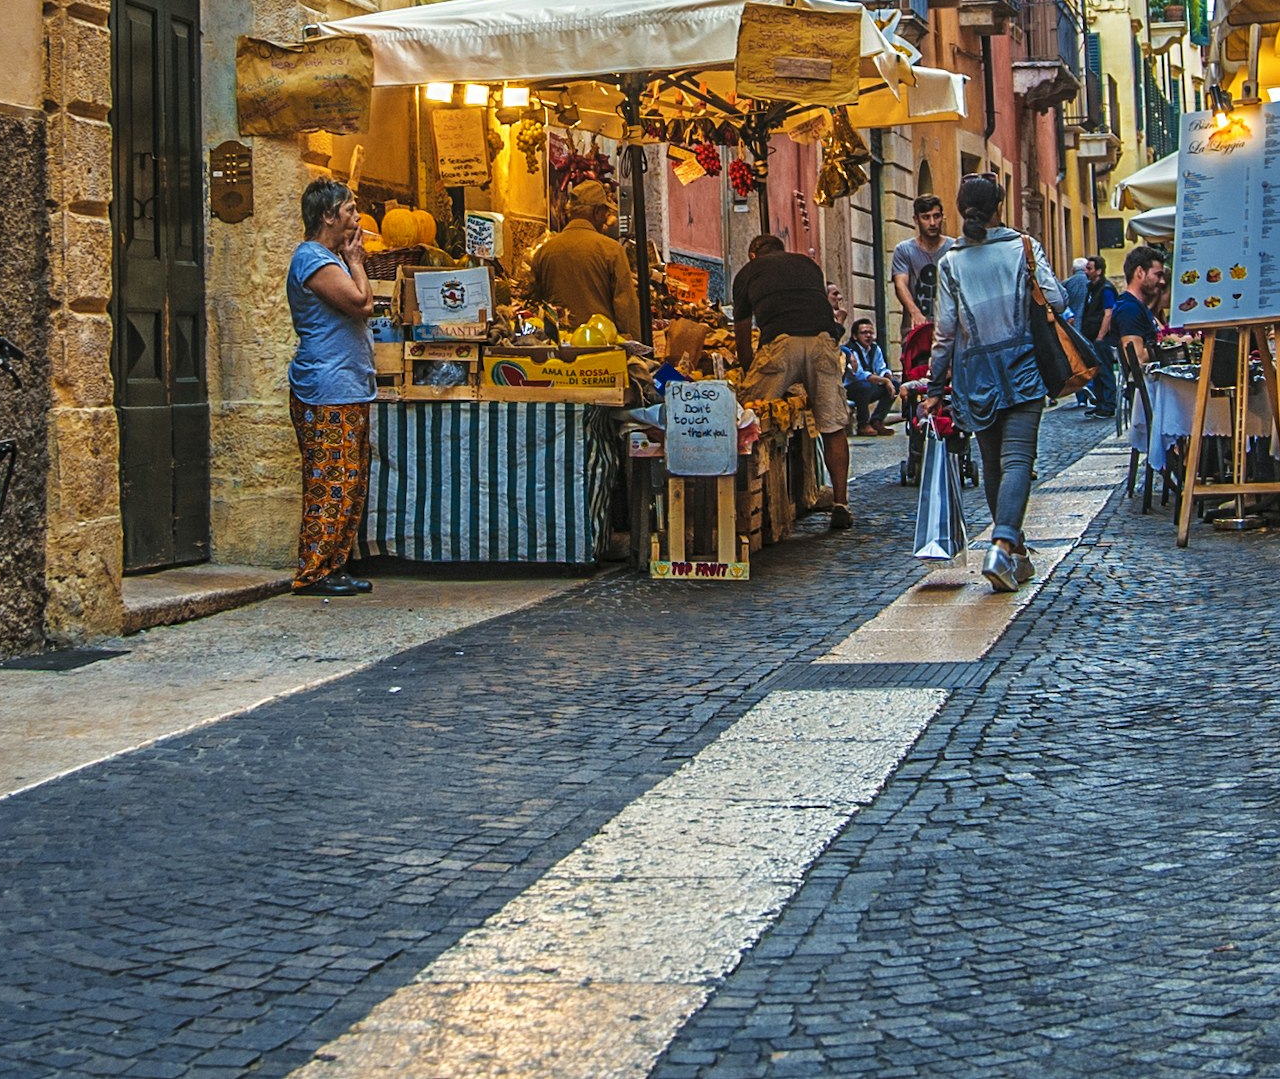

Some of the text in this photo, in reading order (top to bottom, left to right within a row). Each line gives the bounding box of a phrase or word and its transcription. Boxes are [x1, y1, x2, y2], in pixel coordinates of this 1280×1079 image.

[1186, 139, 1246, 156] La Loggia
[542, 367, 563, 376] AMA
[566, 369, 577, 377] LA
[674, 413, 709, 425] touch
[672, 561, 729, 577] TOP FRUIT
